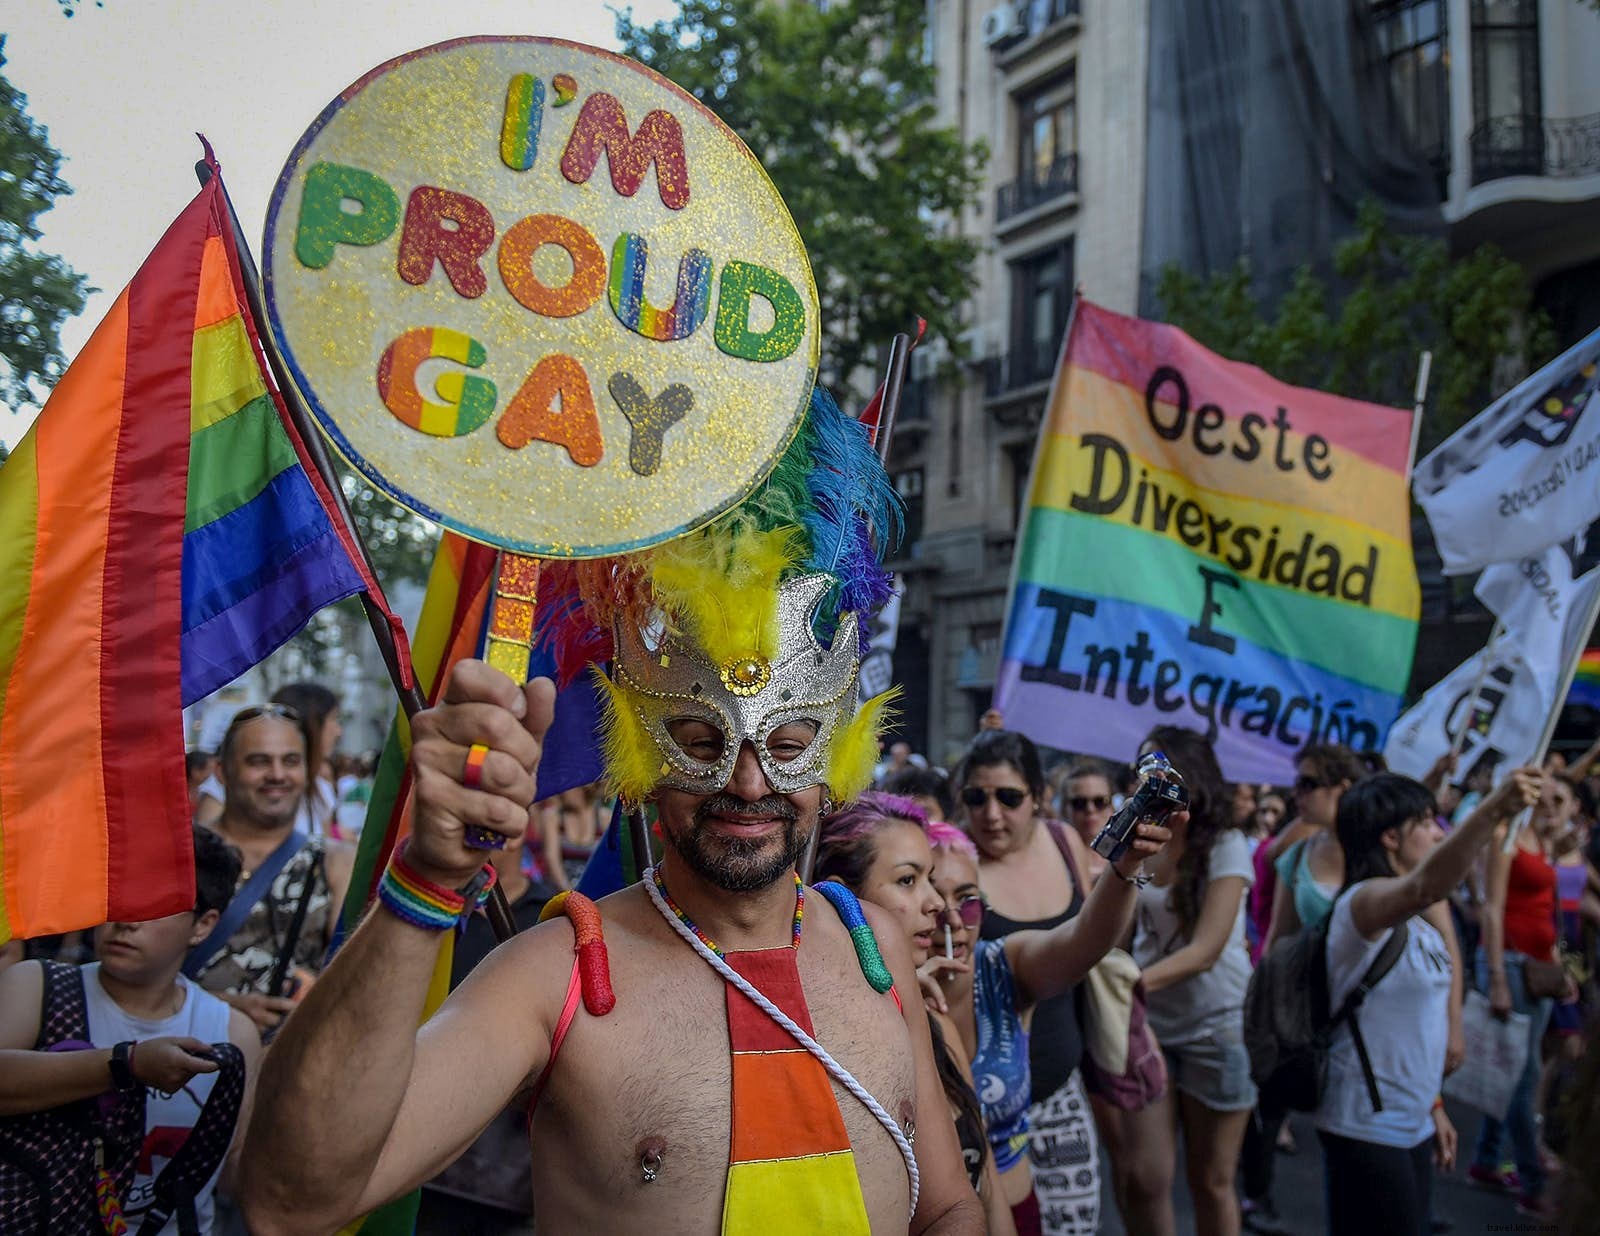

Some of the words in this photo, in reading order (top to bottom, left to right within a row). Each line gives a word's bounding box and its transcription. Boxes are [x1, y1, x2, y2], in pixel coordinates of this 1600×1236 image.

[499, 72, 691, 210] I'M
[294, 160, 805, 362] PROUD
[376, 327, 695, 476] GAY
[1144, 365, 1335, 481] Oeste
[1070, 433, 1379, 607] Diversidad
[1020, 588, 1382, 751] Integración
